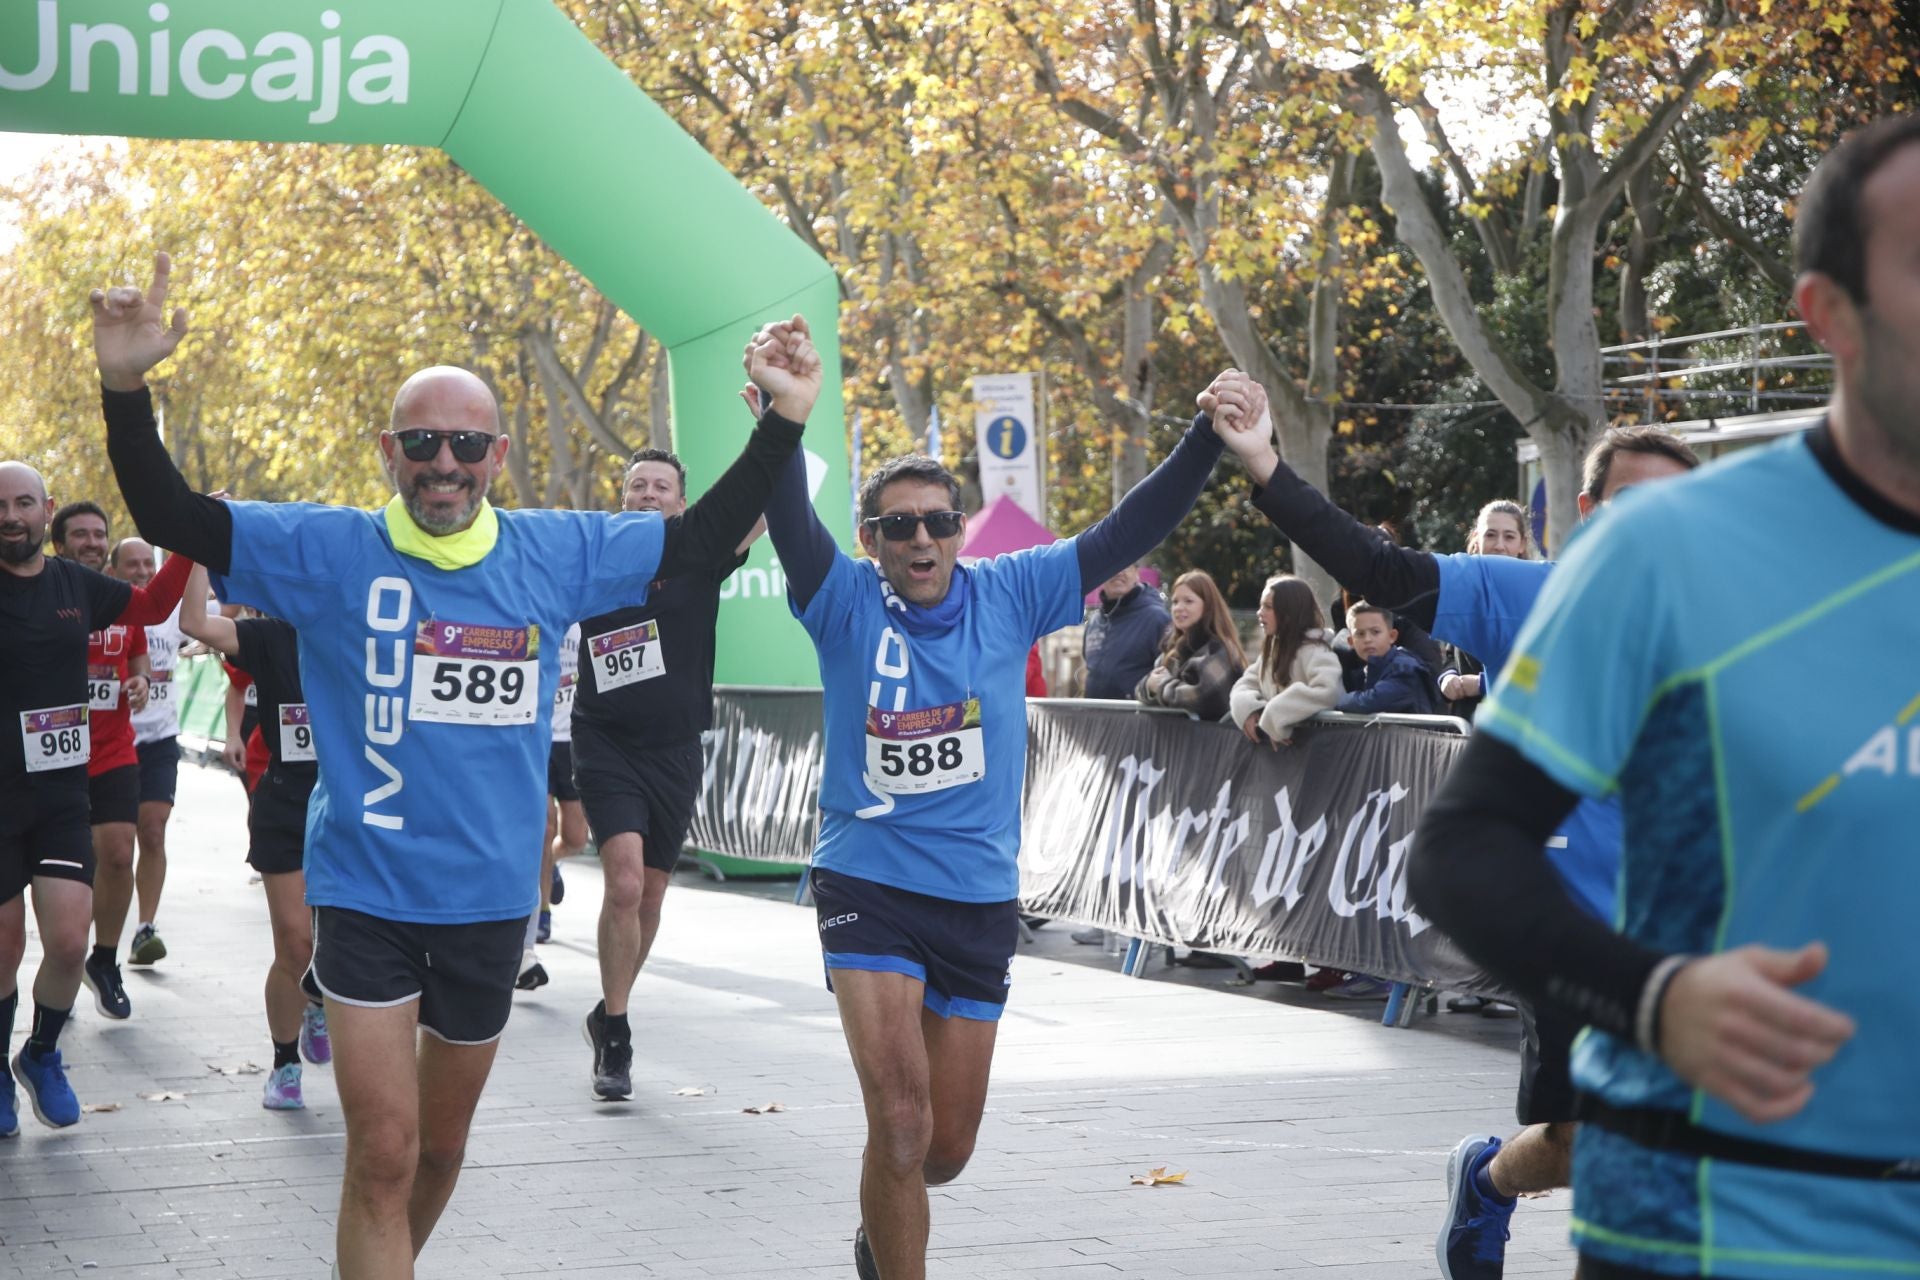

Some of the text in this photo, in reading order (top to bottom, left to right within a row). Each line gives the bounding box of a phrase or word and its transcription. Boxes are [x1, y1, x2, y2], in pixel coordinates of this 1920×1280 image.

[462, 636, 513, 650] EMPRESAS
[463, 626, 503, 638] CARRERA
[503, 630, 514, 639] DE
[605, 645, 645, 676] 967
[431, 662, 524, 705] 589
[363, 576, 412, 830] IVECO
[896, 711, 930, 721] CARRERA
[931, 708, 942, 717] DE
[897, 717, 942, 730] EMPRESAS
[40, 728, 81, 757] 968
[881, 737, 963, 777] 588
[1250, 785, 1327, 912] de
